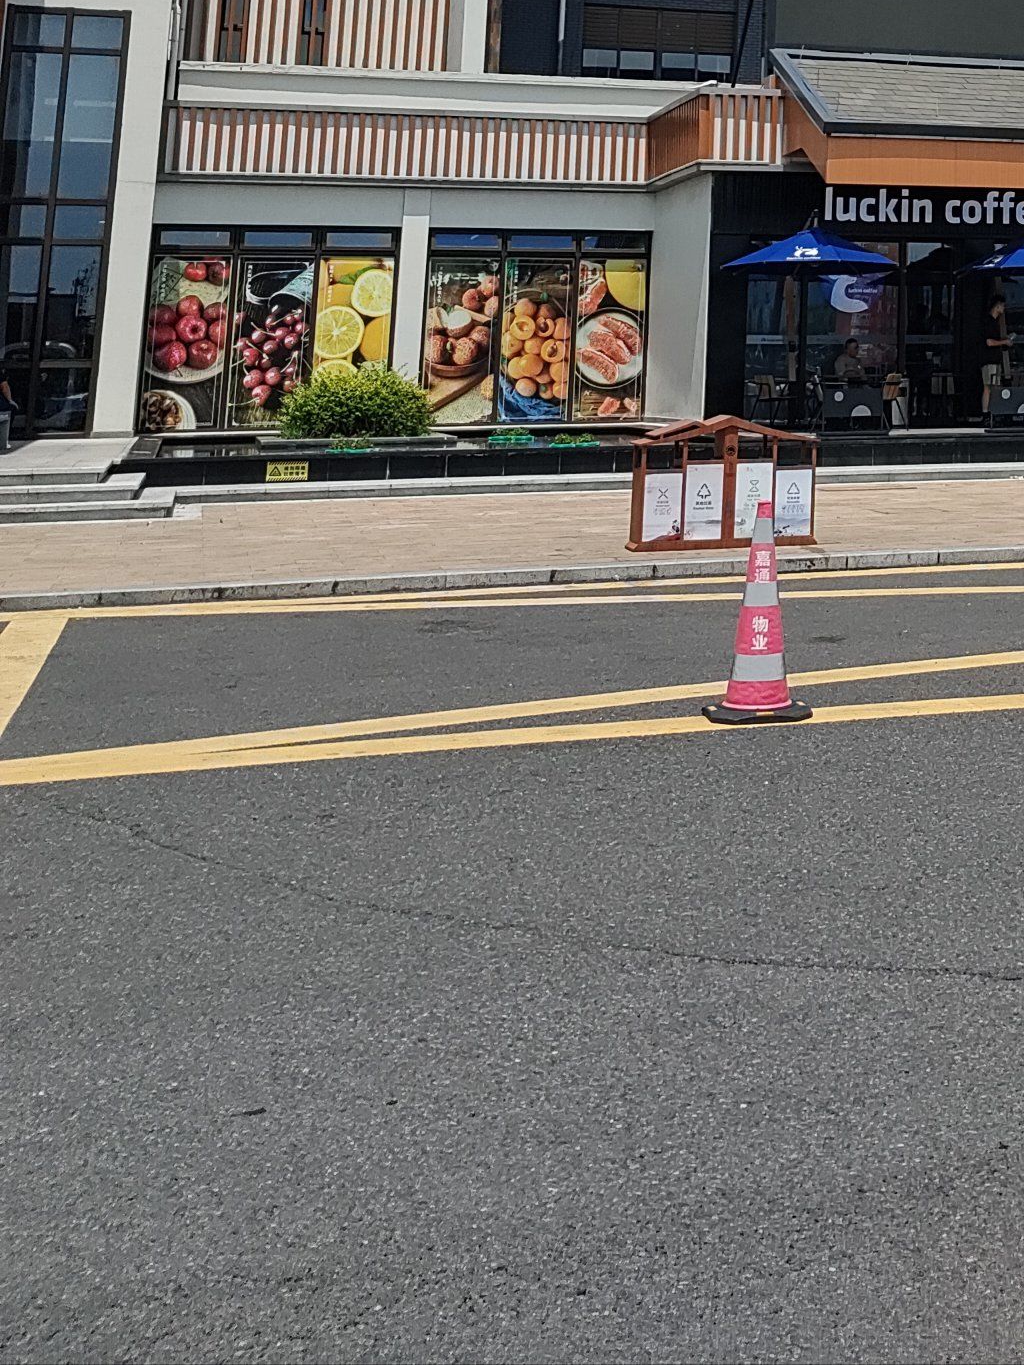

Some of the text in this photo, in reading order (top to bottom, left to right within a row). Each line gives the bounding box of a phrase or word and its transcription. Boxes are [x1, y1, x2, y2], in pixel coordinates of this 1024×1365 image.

[824, 186, 933, 223] luckin
[754, 550, 771, 584] 嘉通
[751, 615, 770, 651] 物业
